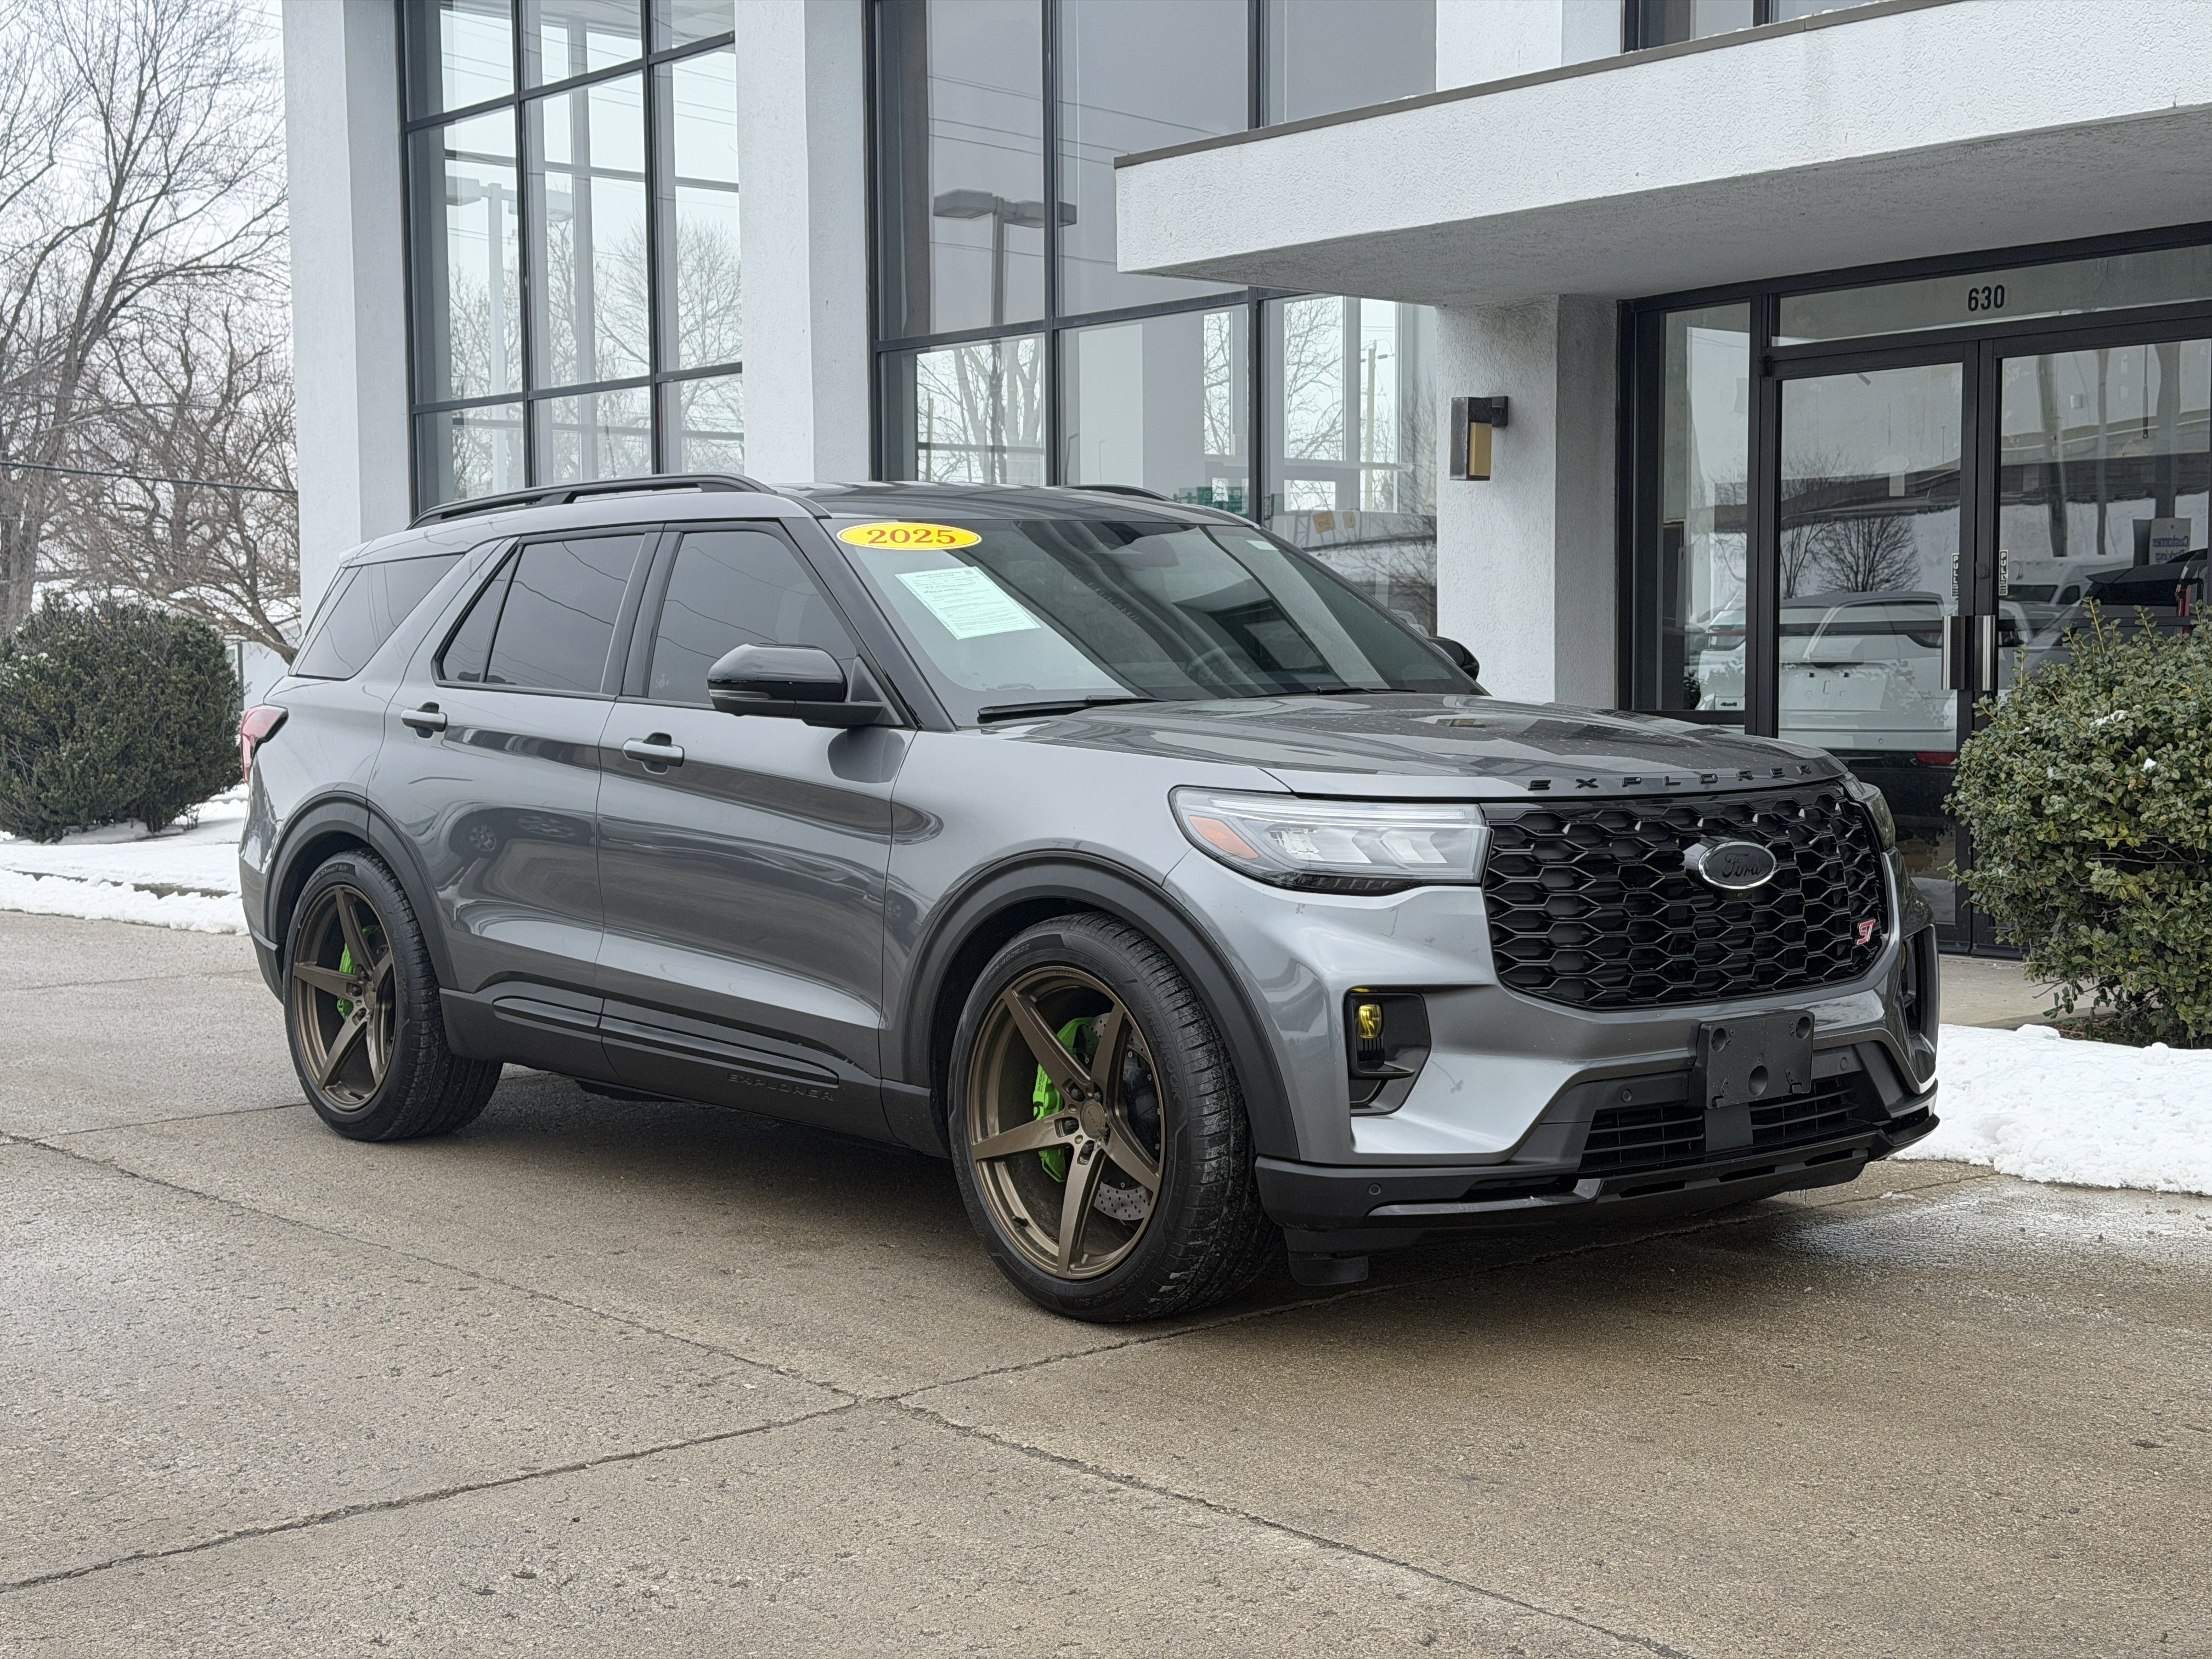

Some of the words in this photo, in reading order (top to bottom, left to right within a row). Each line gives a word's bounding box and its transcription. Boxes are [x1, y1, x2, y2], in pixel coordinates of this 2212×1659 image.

[1968, 284, 2005, 311] 630
[867, 529, 956, 544] 2025
[1528, 764, 1812, 791] EXPLORER
[1722, 853, 1762, 878] Ford
[1857, 918, 1876, 945] ST
[727, 1073, 834, 1101] EXPLORER
